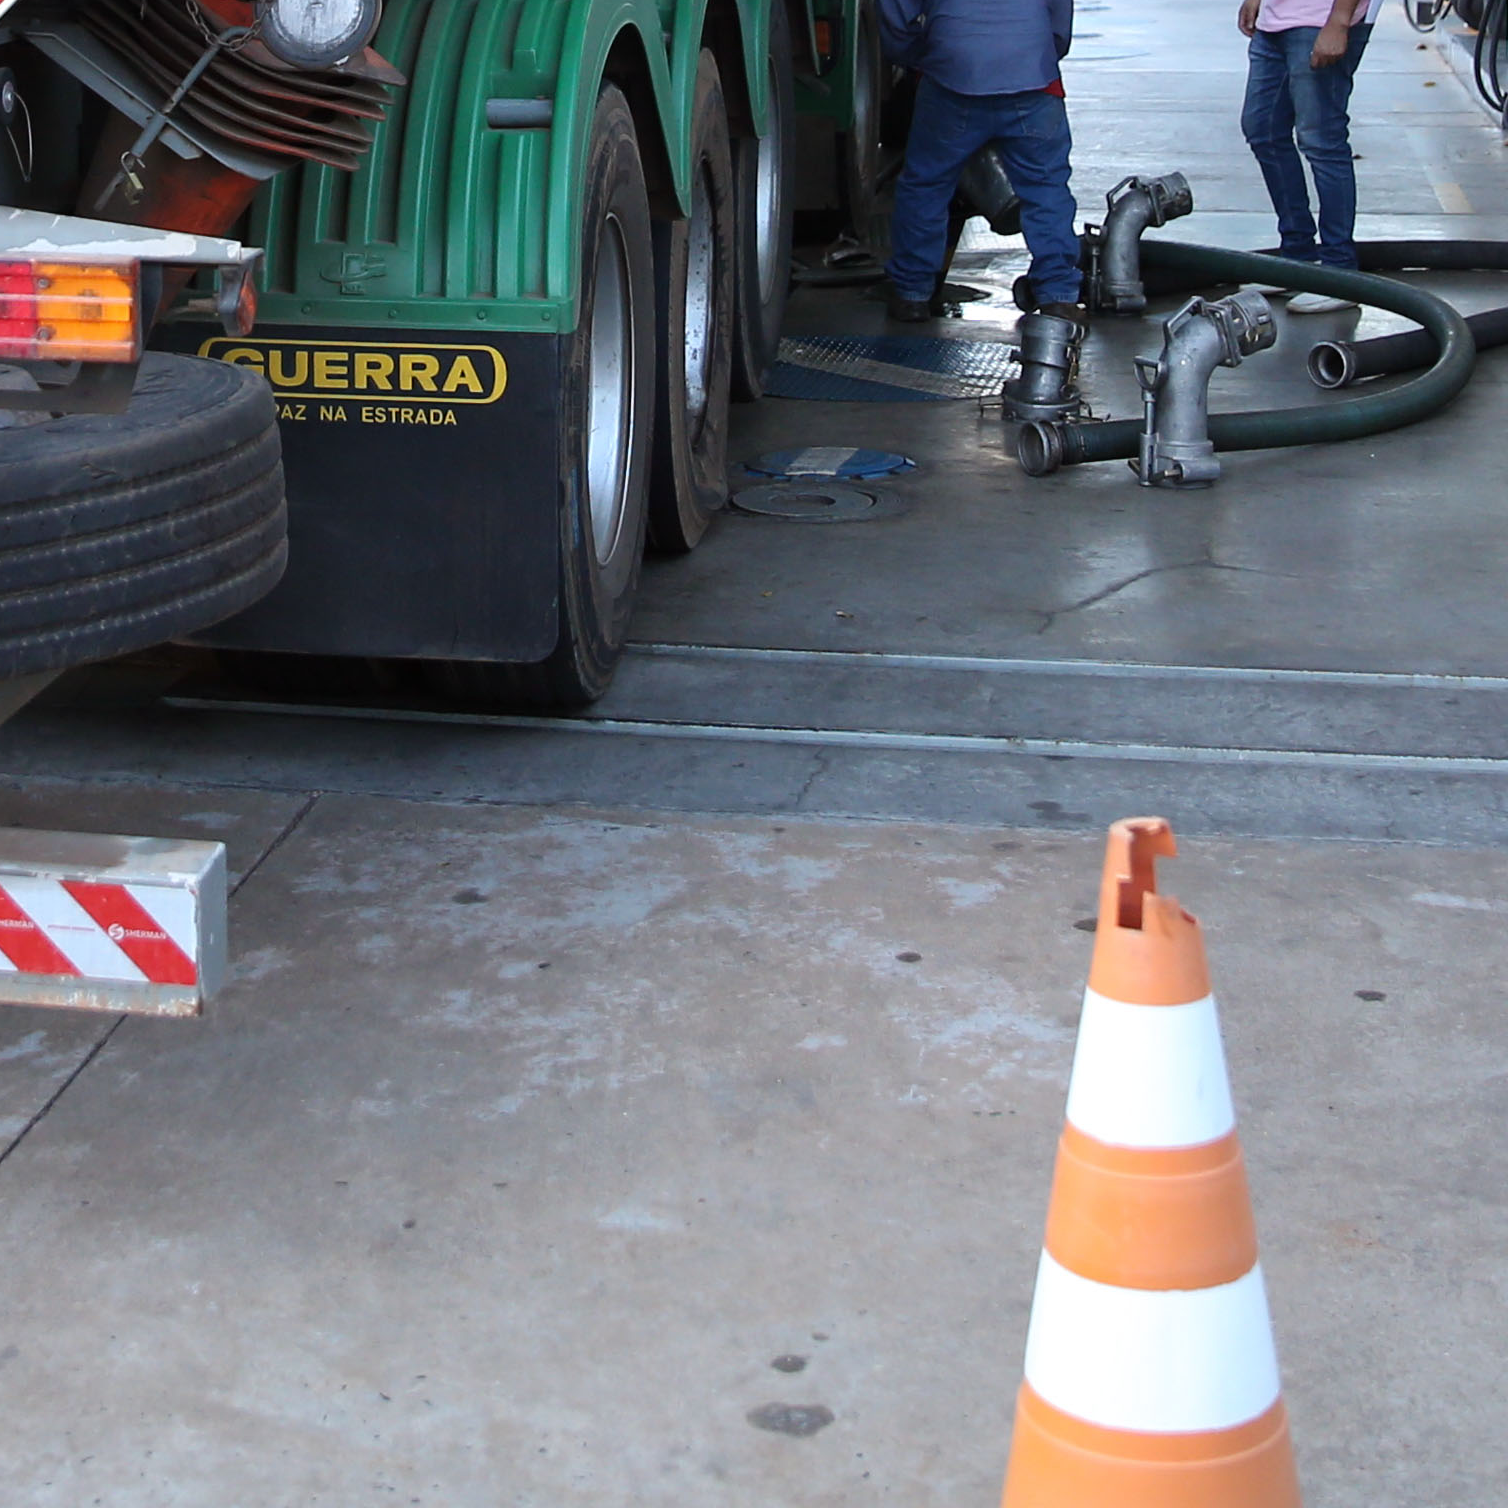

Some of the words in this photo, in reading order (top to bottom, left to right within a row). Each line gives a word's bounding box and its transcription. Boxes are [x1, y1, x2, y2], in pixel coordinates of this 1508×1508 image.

[320, 406, 347, 422] NA
[361, 407, 458, 426] ESTRADA
[125, 928, 167, 940] SHERMAN
